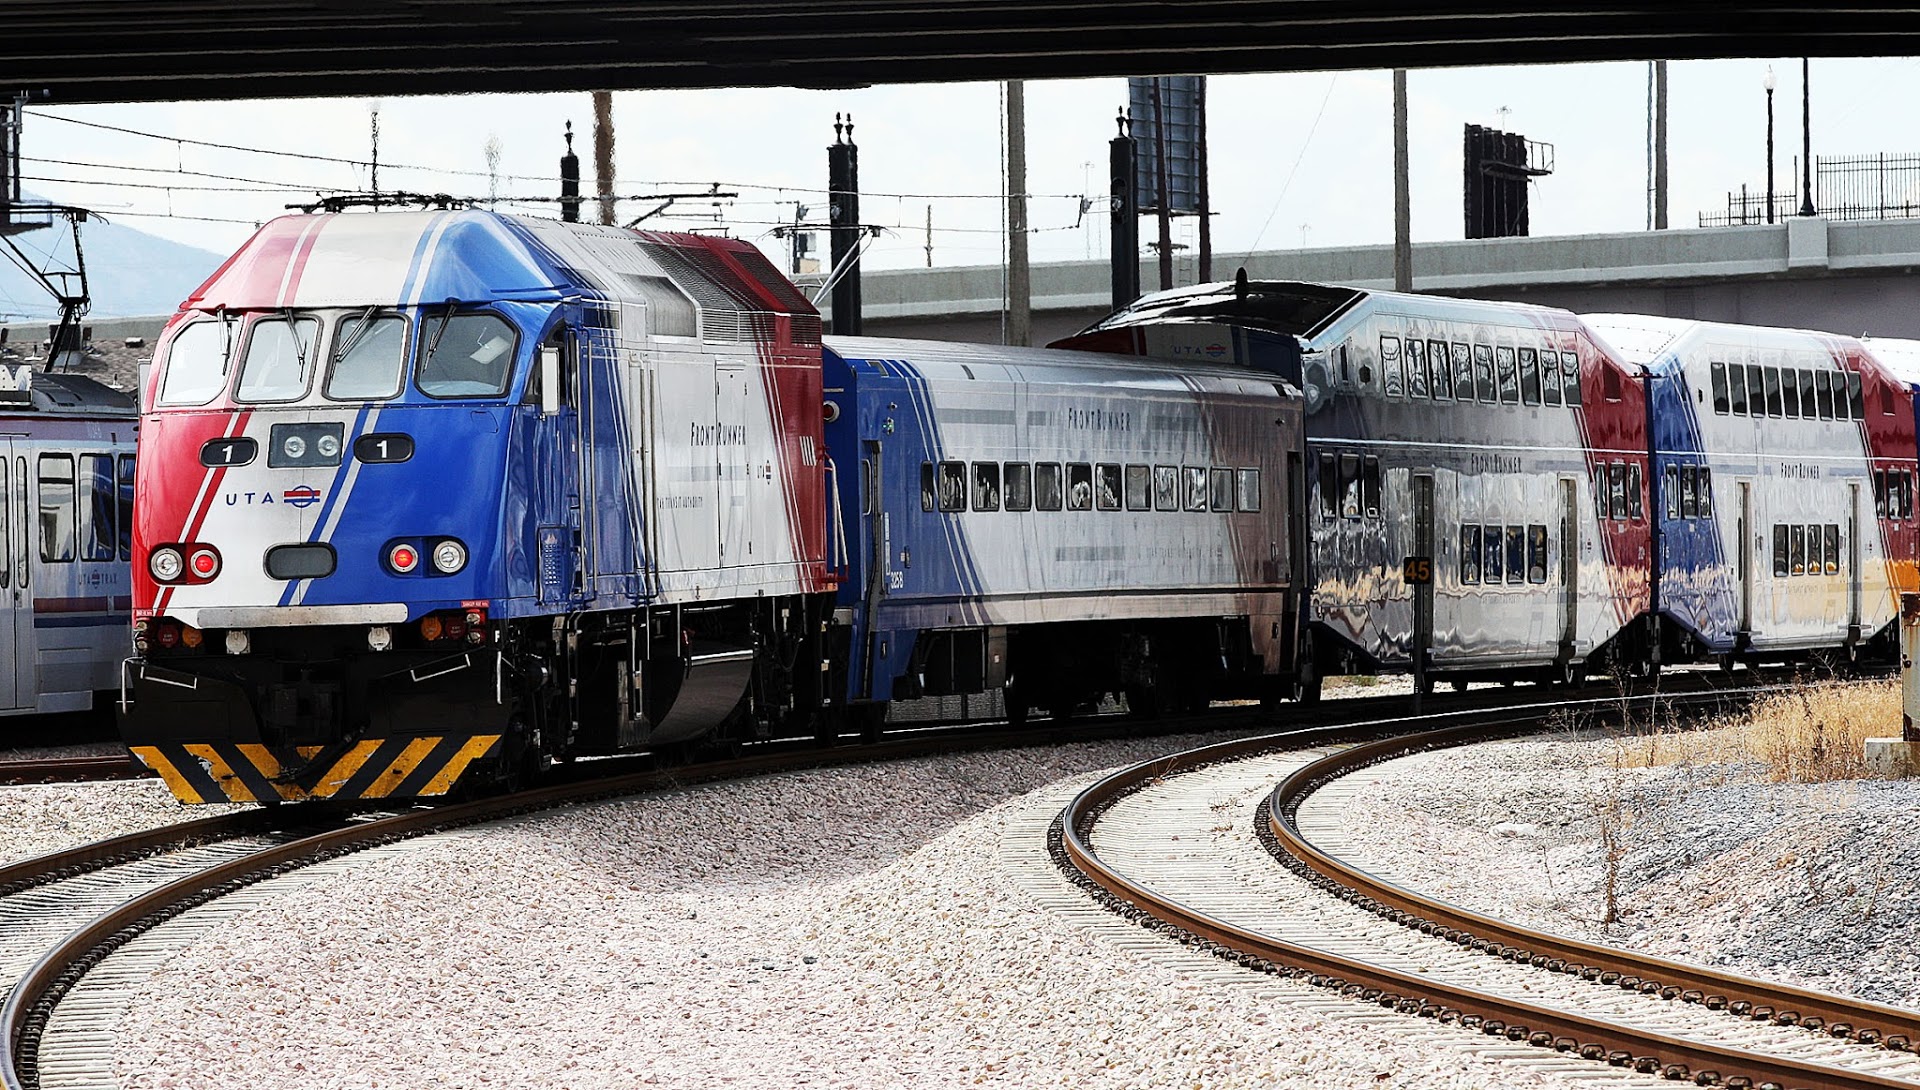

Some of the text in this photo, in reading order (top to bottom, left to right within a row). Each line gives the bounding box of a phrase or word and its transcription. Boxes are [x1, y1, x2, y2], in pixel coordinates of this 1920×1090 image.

[1174, 346, 1202, 354] UTA
[222, 445, 233, 463] 1
[376, 440, 388, 459] 1
[226, 492, 274, 506] UTA
[1405, 560, 1430, 580] 45
